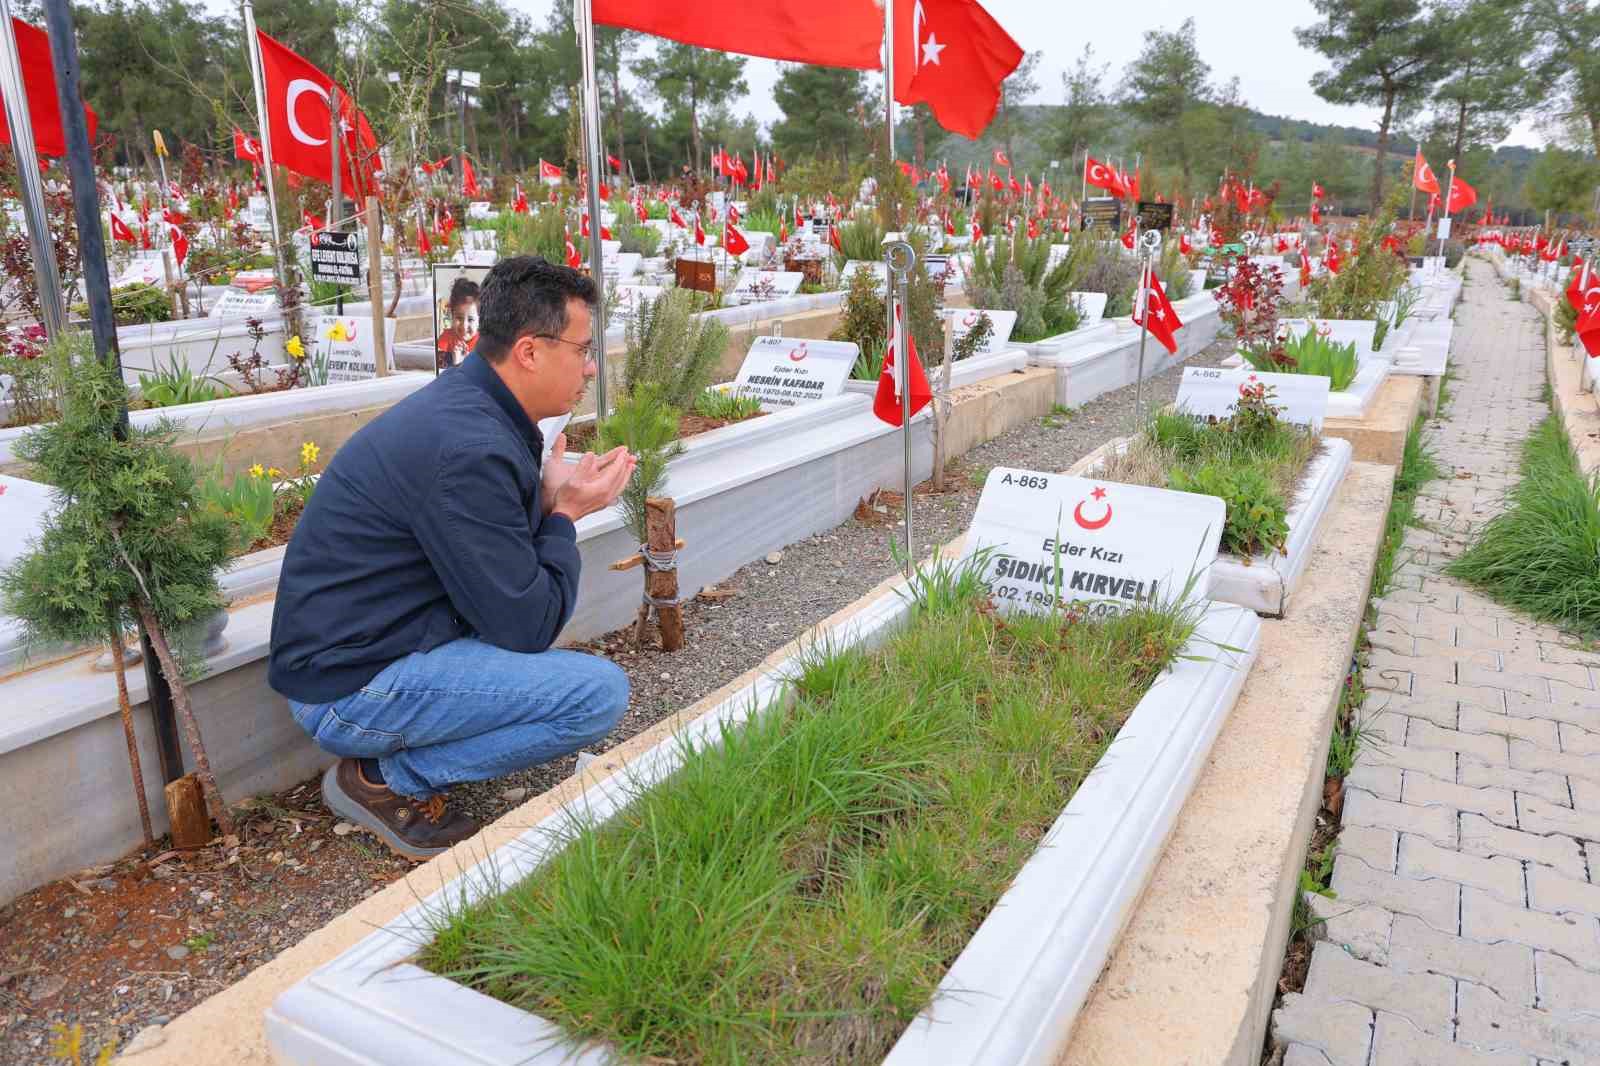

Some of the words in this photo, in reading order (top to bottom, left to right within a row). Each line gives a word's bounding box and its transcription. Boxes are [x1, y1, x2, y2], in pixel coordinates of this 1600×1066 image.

[747, 374, 780, 387] NESRİN
[781, 377, 824, 391] KAFADAR
[1000, 473, 1048, 490] A-863
[1089, 546, 1124, 564] Kızı
